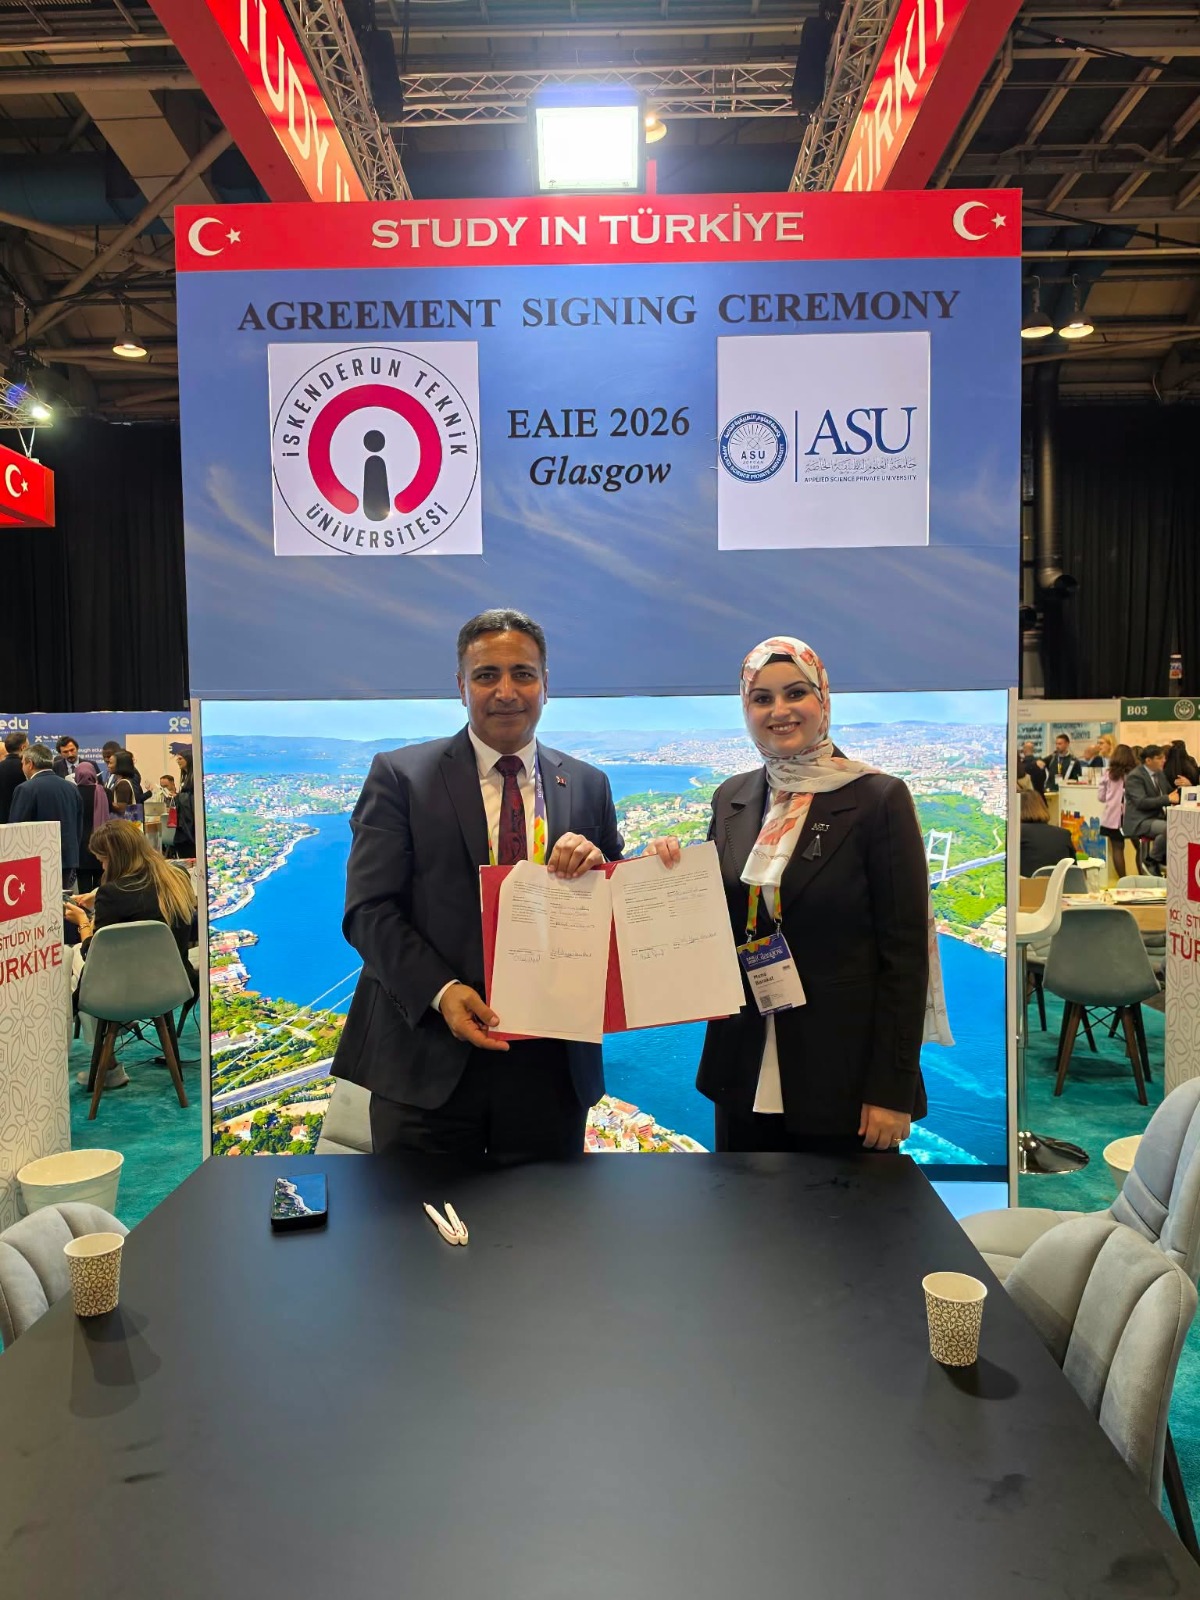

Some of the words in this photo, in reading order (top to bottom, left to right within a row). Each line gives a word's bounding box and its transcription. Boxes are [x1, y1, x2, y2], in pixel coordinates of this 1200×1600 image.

[371, 217, 528, 249] STUDY
[540, 216, 587, 246] IN
[599, 203, 804, 245] TÜRKİYE
[237, 298, 501, 331] AGREEMENT
[523, 295, 697, 327] SIGNING
[718, 290, 961, 323] CEREMONY
[282, 357, 402, 457] İSKENDERUN
[414, 370, 468, 455] TEKNİK
[507, 408, 598, 438] EAIE
[610, 406, 690, 437] 2026
[804, 407, 917, 456] ASU
[529, 455, 672, 492] Glasgow
[741, 450, 766, 460] ASU
[306, 501, 449, 548] ÜNİVERSİTESİ
[1127, 706, 1148, 716] B03
[34, 925, 45, 940] IN
[1186, 913, 1200, 929] ST
